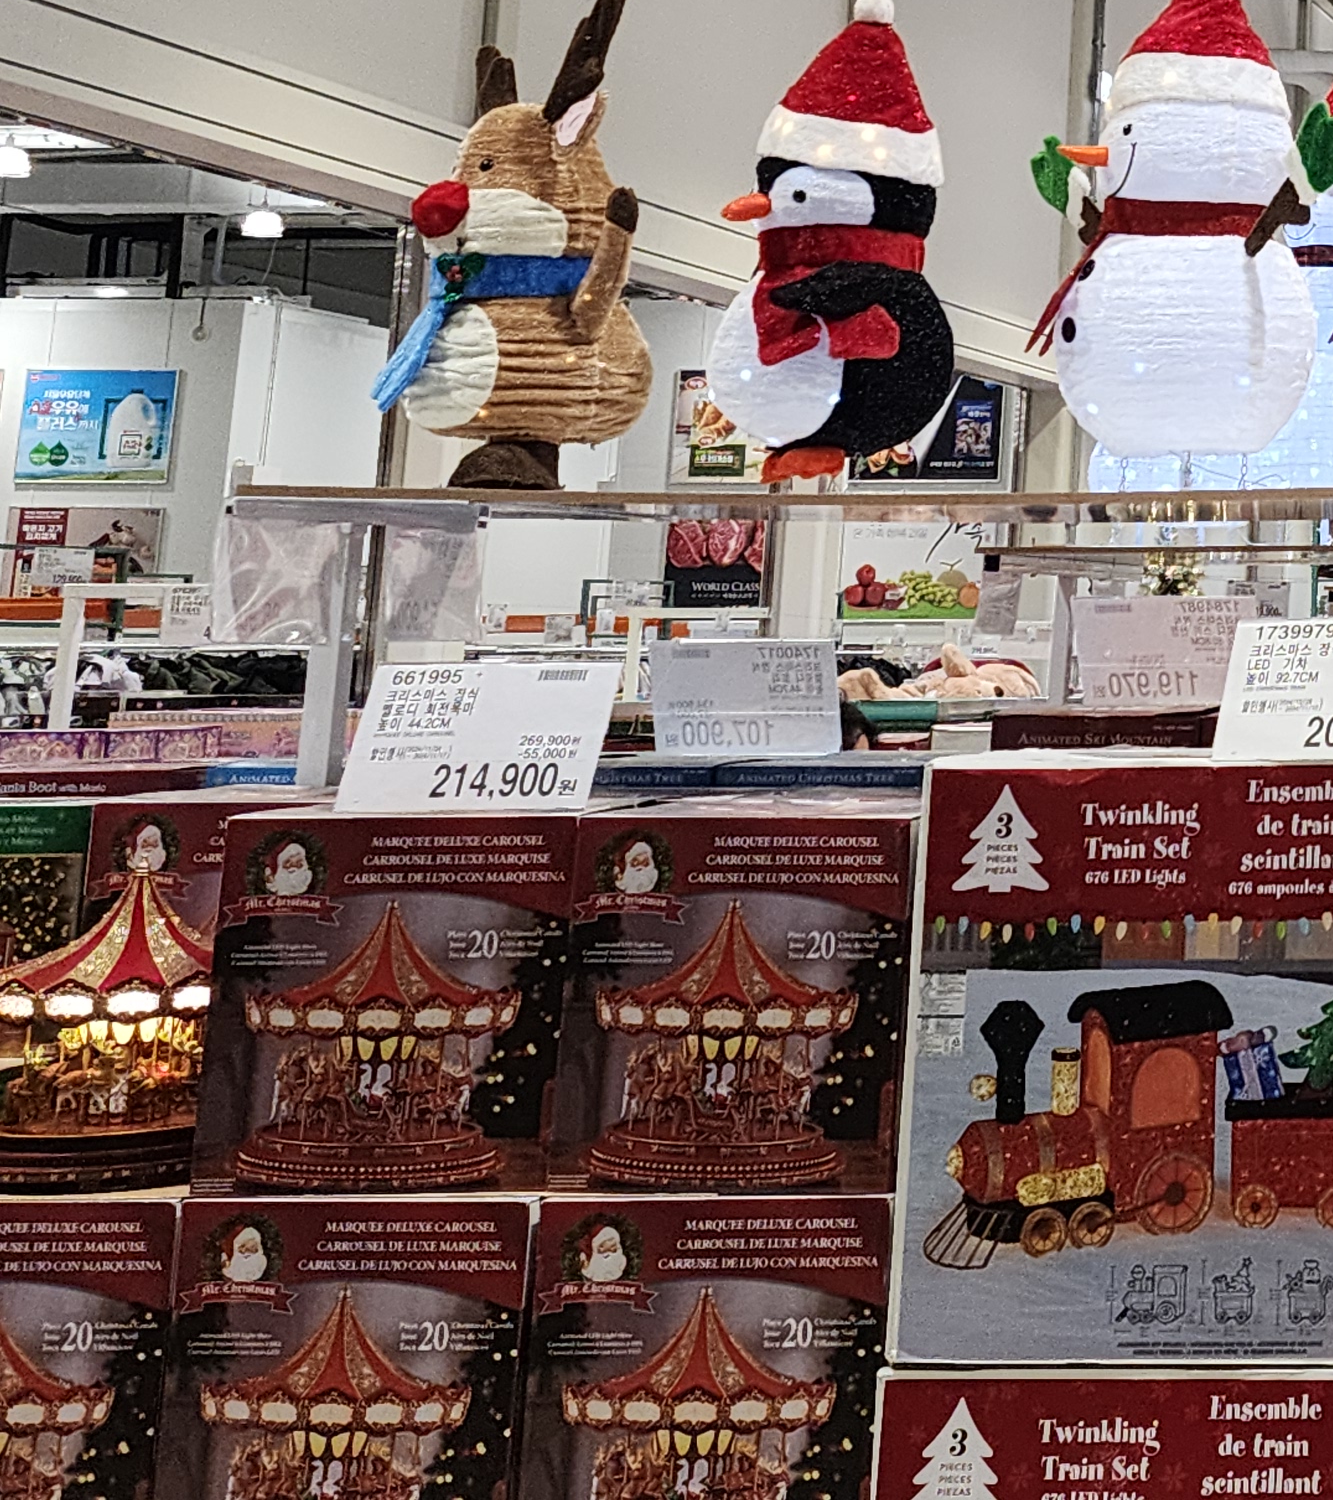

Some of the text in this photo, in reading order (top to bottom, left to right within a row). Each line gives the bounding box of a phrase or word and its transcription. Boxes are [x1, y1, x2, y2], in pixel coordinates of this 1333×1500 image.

[692, 581, 760, 593] WORLD CLASS
[1249, 643, 1312, 657] 크리스마스
[1247, 657, 1308, 671] LED 기차
[391, 669, 464, 685] 661995
[1245, 671, 1320, 687] 높이 92.7CM
[384, 687, 479, 703] 크리스마스 장식
[376, 717, 453, 732] 높이 44.2CM
[429, 762, 578, 801] 214,900원
[995, 812, 1014, 839] 3
[1080, 800, 1201, 836] Twinkling
[1256, 814, 1285, 836] de
[714, 836, 879, 848] MARQUEE DELUXE CAROUSEL
[1084, 836, 1193, 860] Train Set
[706, 854, 885, 867] CARROUSEL DE LUXE MARQUISE
[688, 872, 899, 885] CARRUSEL DE LUJO CON MARQUESINA
[1085, 869, 1187, 890] 676 LED Lights
[1228, 881, 1254, 896] 676
[1256, 878, 1326, 900] ampoules
[805, 930, 836, 960] 20
[325, 1221, 497, 1233] MARQUEE DELUXE CAROUSEL
[685, 1218, 859, 1231] MARQUEE DELUXE CAROUSEL
[317, 1241, 502, 1253] CARROUSEL DE LUXE MARQUISE
[677, 1237, 863, 1251] CARROUSEL DE LUXE MARQUISE
[298, 1260, 517, 1273] CARRUSEL DE LUJO CON MARQUESINA
[658, 1256, 878, 1271] CARRUSEL DE LUJO CON MARQUESINA
[418, 1320, 450, 1353] 20
[781, 1317, 813, 1349] 20
[1207, 1393, 1323, 1422] Ensemble
[949, 1428, 968, 1457] 3
[1038, 1417, 1161, 1456] Twinkling
[1218, 1433, 1309, 1458] de train
[1041, 1456, 1150, 1482] Train Set
[1200, 1467, 1323, 1497] scintillant
